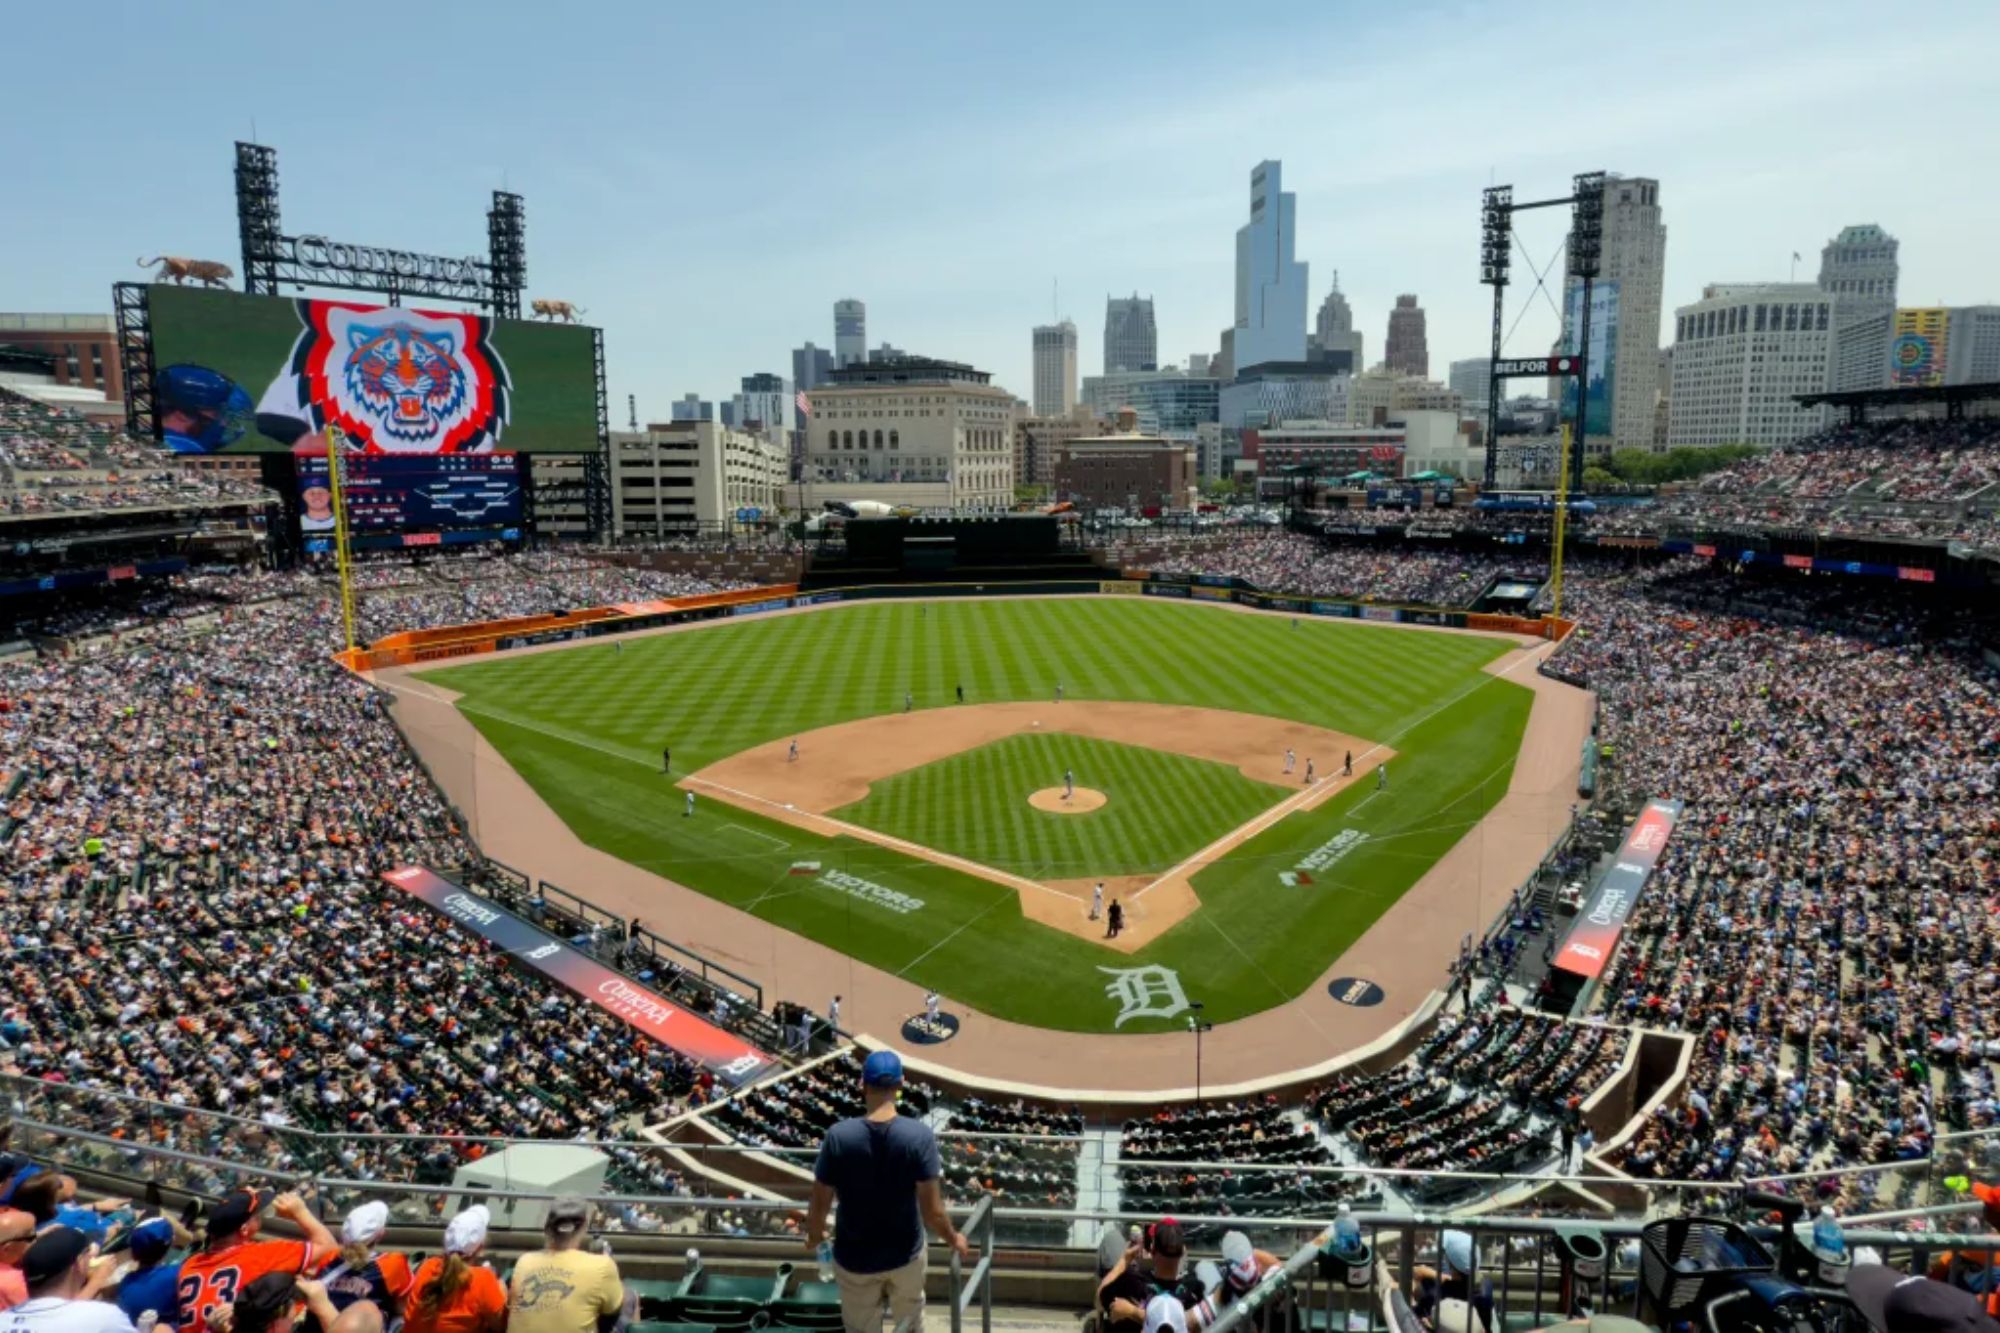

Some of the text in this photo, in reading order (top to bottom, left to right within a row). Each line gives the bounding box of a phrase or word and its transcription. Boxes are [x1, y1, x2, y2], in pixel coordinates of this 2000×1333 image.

[1495, 361, 1548, 374] BELFOR
[824, 868, 926, 910] VICTORS
[1096, 963, 1190, 1030] D
[179, 1266, 241, 1328] 23
